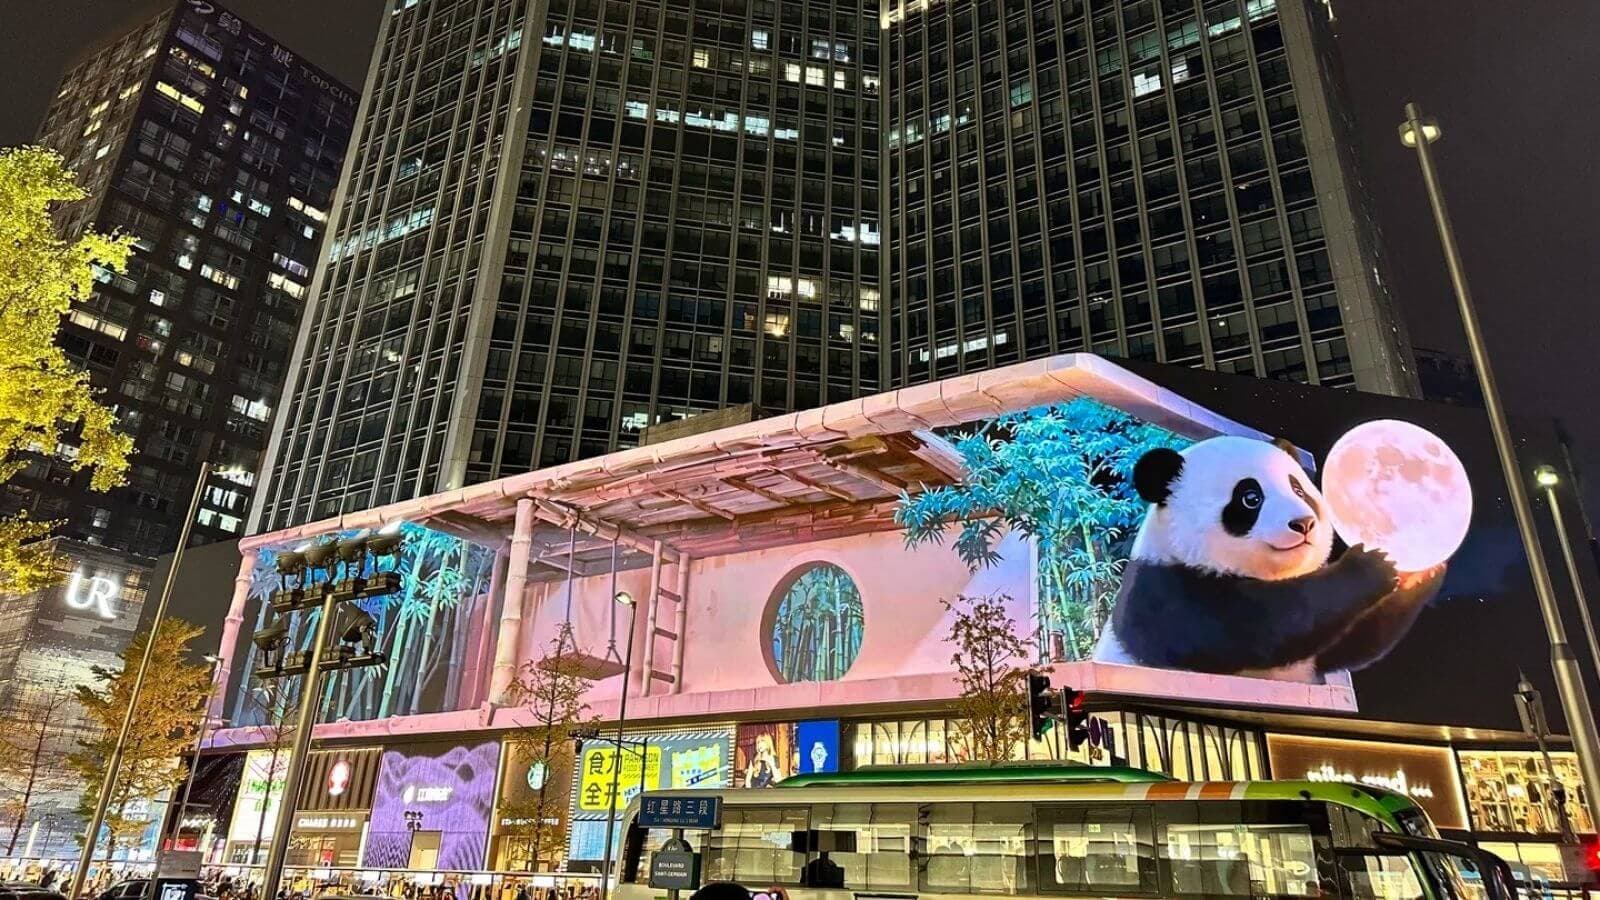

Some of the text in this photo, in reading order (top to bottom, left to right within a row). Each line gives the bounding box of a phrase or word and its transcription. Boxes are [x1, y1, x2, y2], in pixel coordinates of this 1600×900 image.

[67, 571, 117, 619] UR
[589, 751, 622, 775] 食力
[584, 782, 620, 806] 全开
[647, 800, 708, 815] 红星路三段
